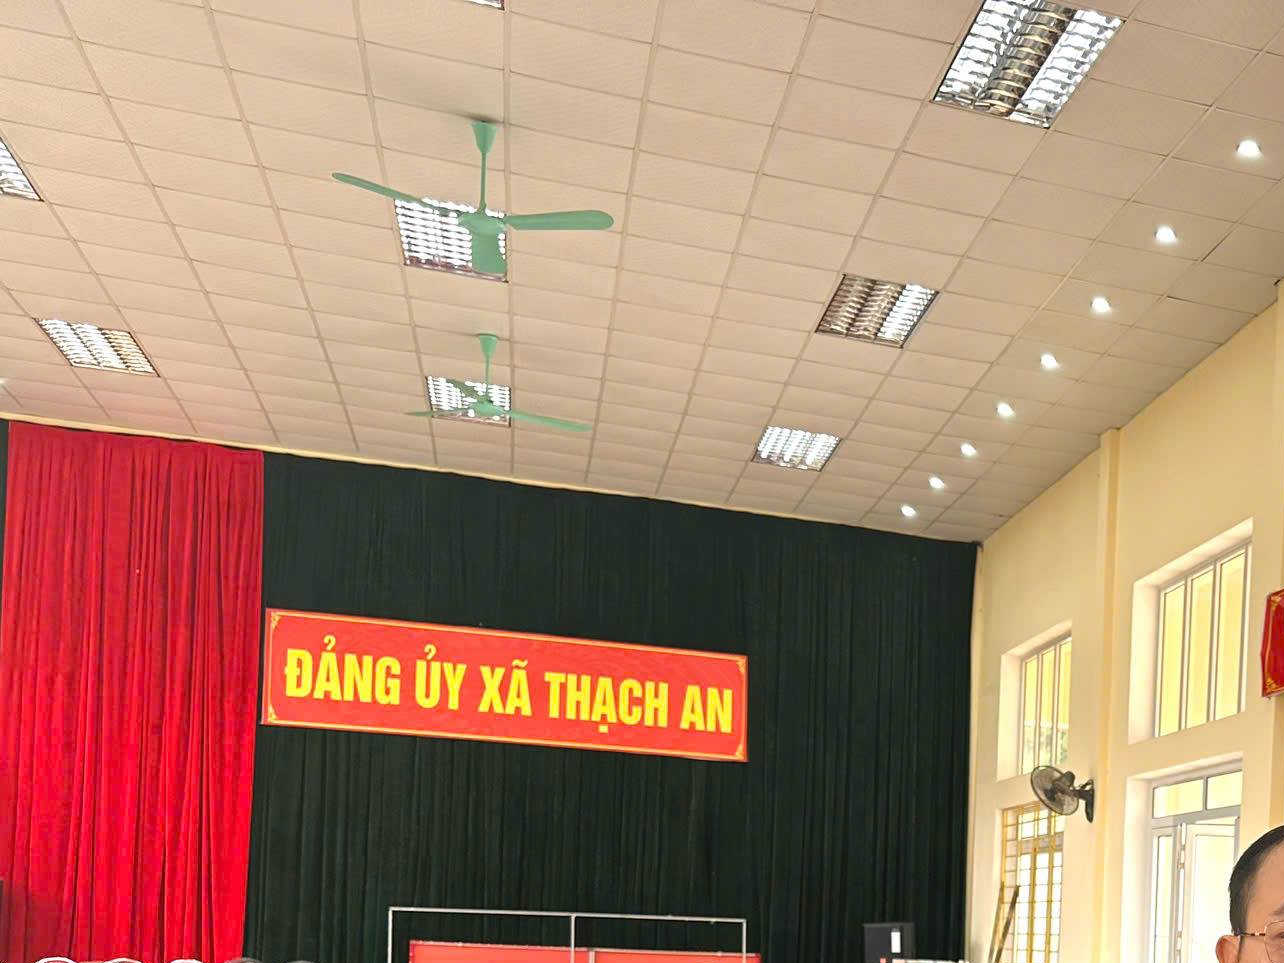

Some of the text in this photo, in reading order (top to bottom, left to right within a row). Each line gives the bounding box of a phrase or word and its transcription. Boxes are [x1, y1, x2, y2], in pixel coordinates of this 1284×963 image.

[284, 634, 733, 734] ĐẢNG ỦY XÃ THẠCH AN
